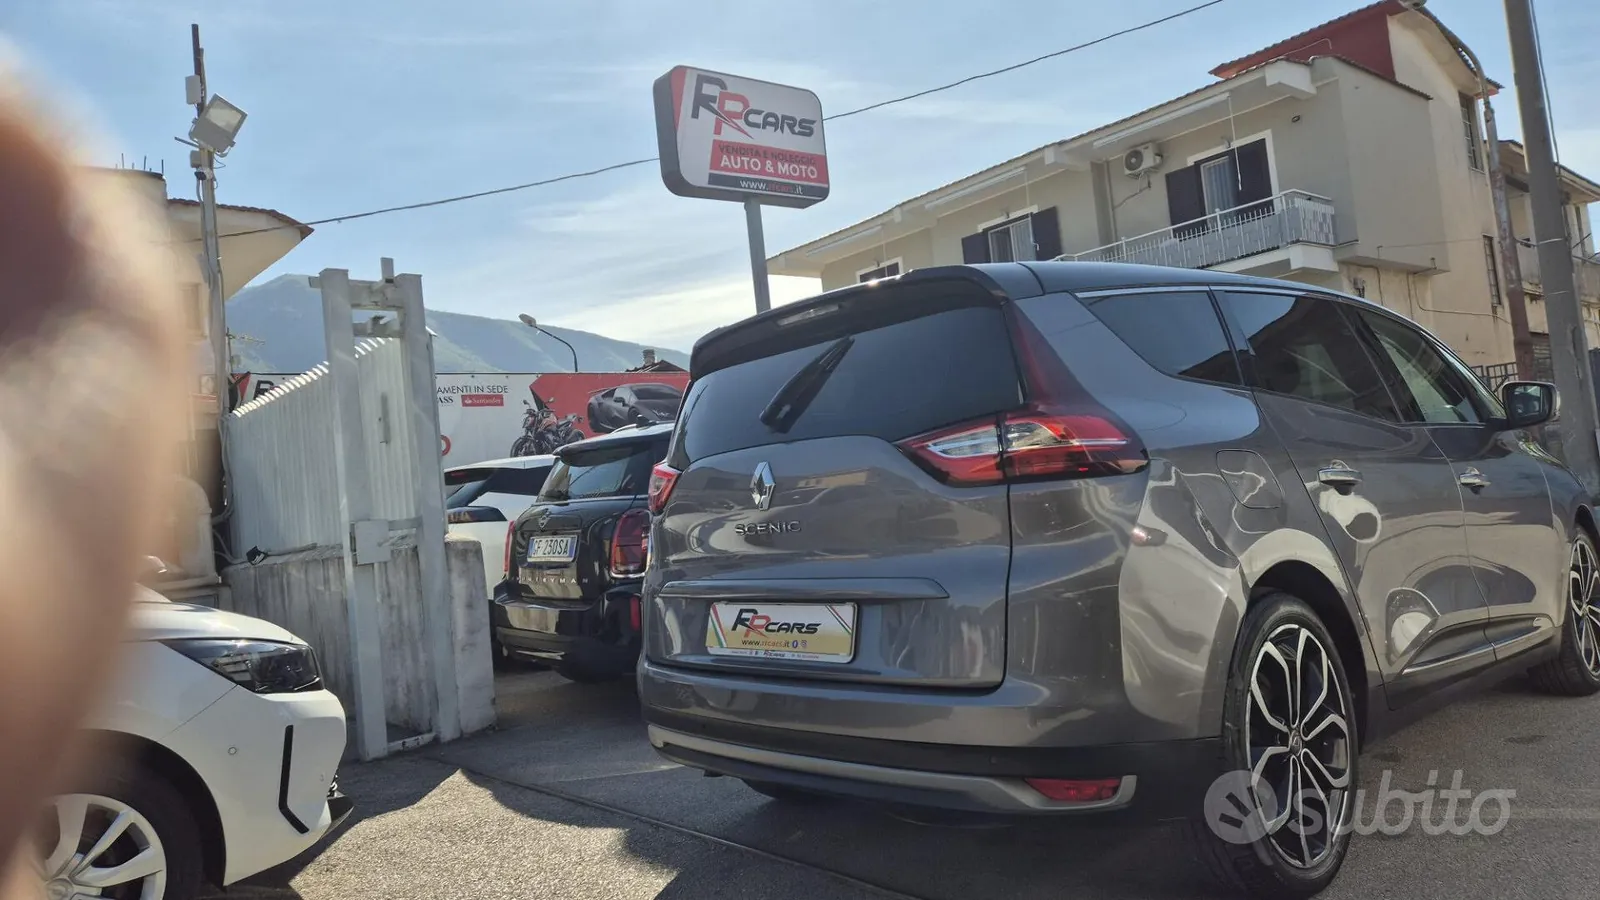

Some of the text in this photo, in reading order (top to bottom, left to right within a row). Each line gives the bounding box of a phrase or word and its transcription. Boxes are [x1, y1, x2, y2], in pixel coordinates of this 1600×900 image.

[718, 144, 760, 157] VENDITA
[770, 151, 816, 165] NOLEGGIO
[720, 155, 818, 179] AUTO & MOTO
[474, 385, 484, 394] IN
[487, 385, 509, 394] SEDE
[472, 396, 501, 405] Santander
[735, 521, 801, 536] SCENIC
